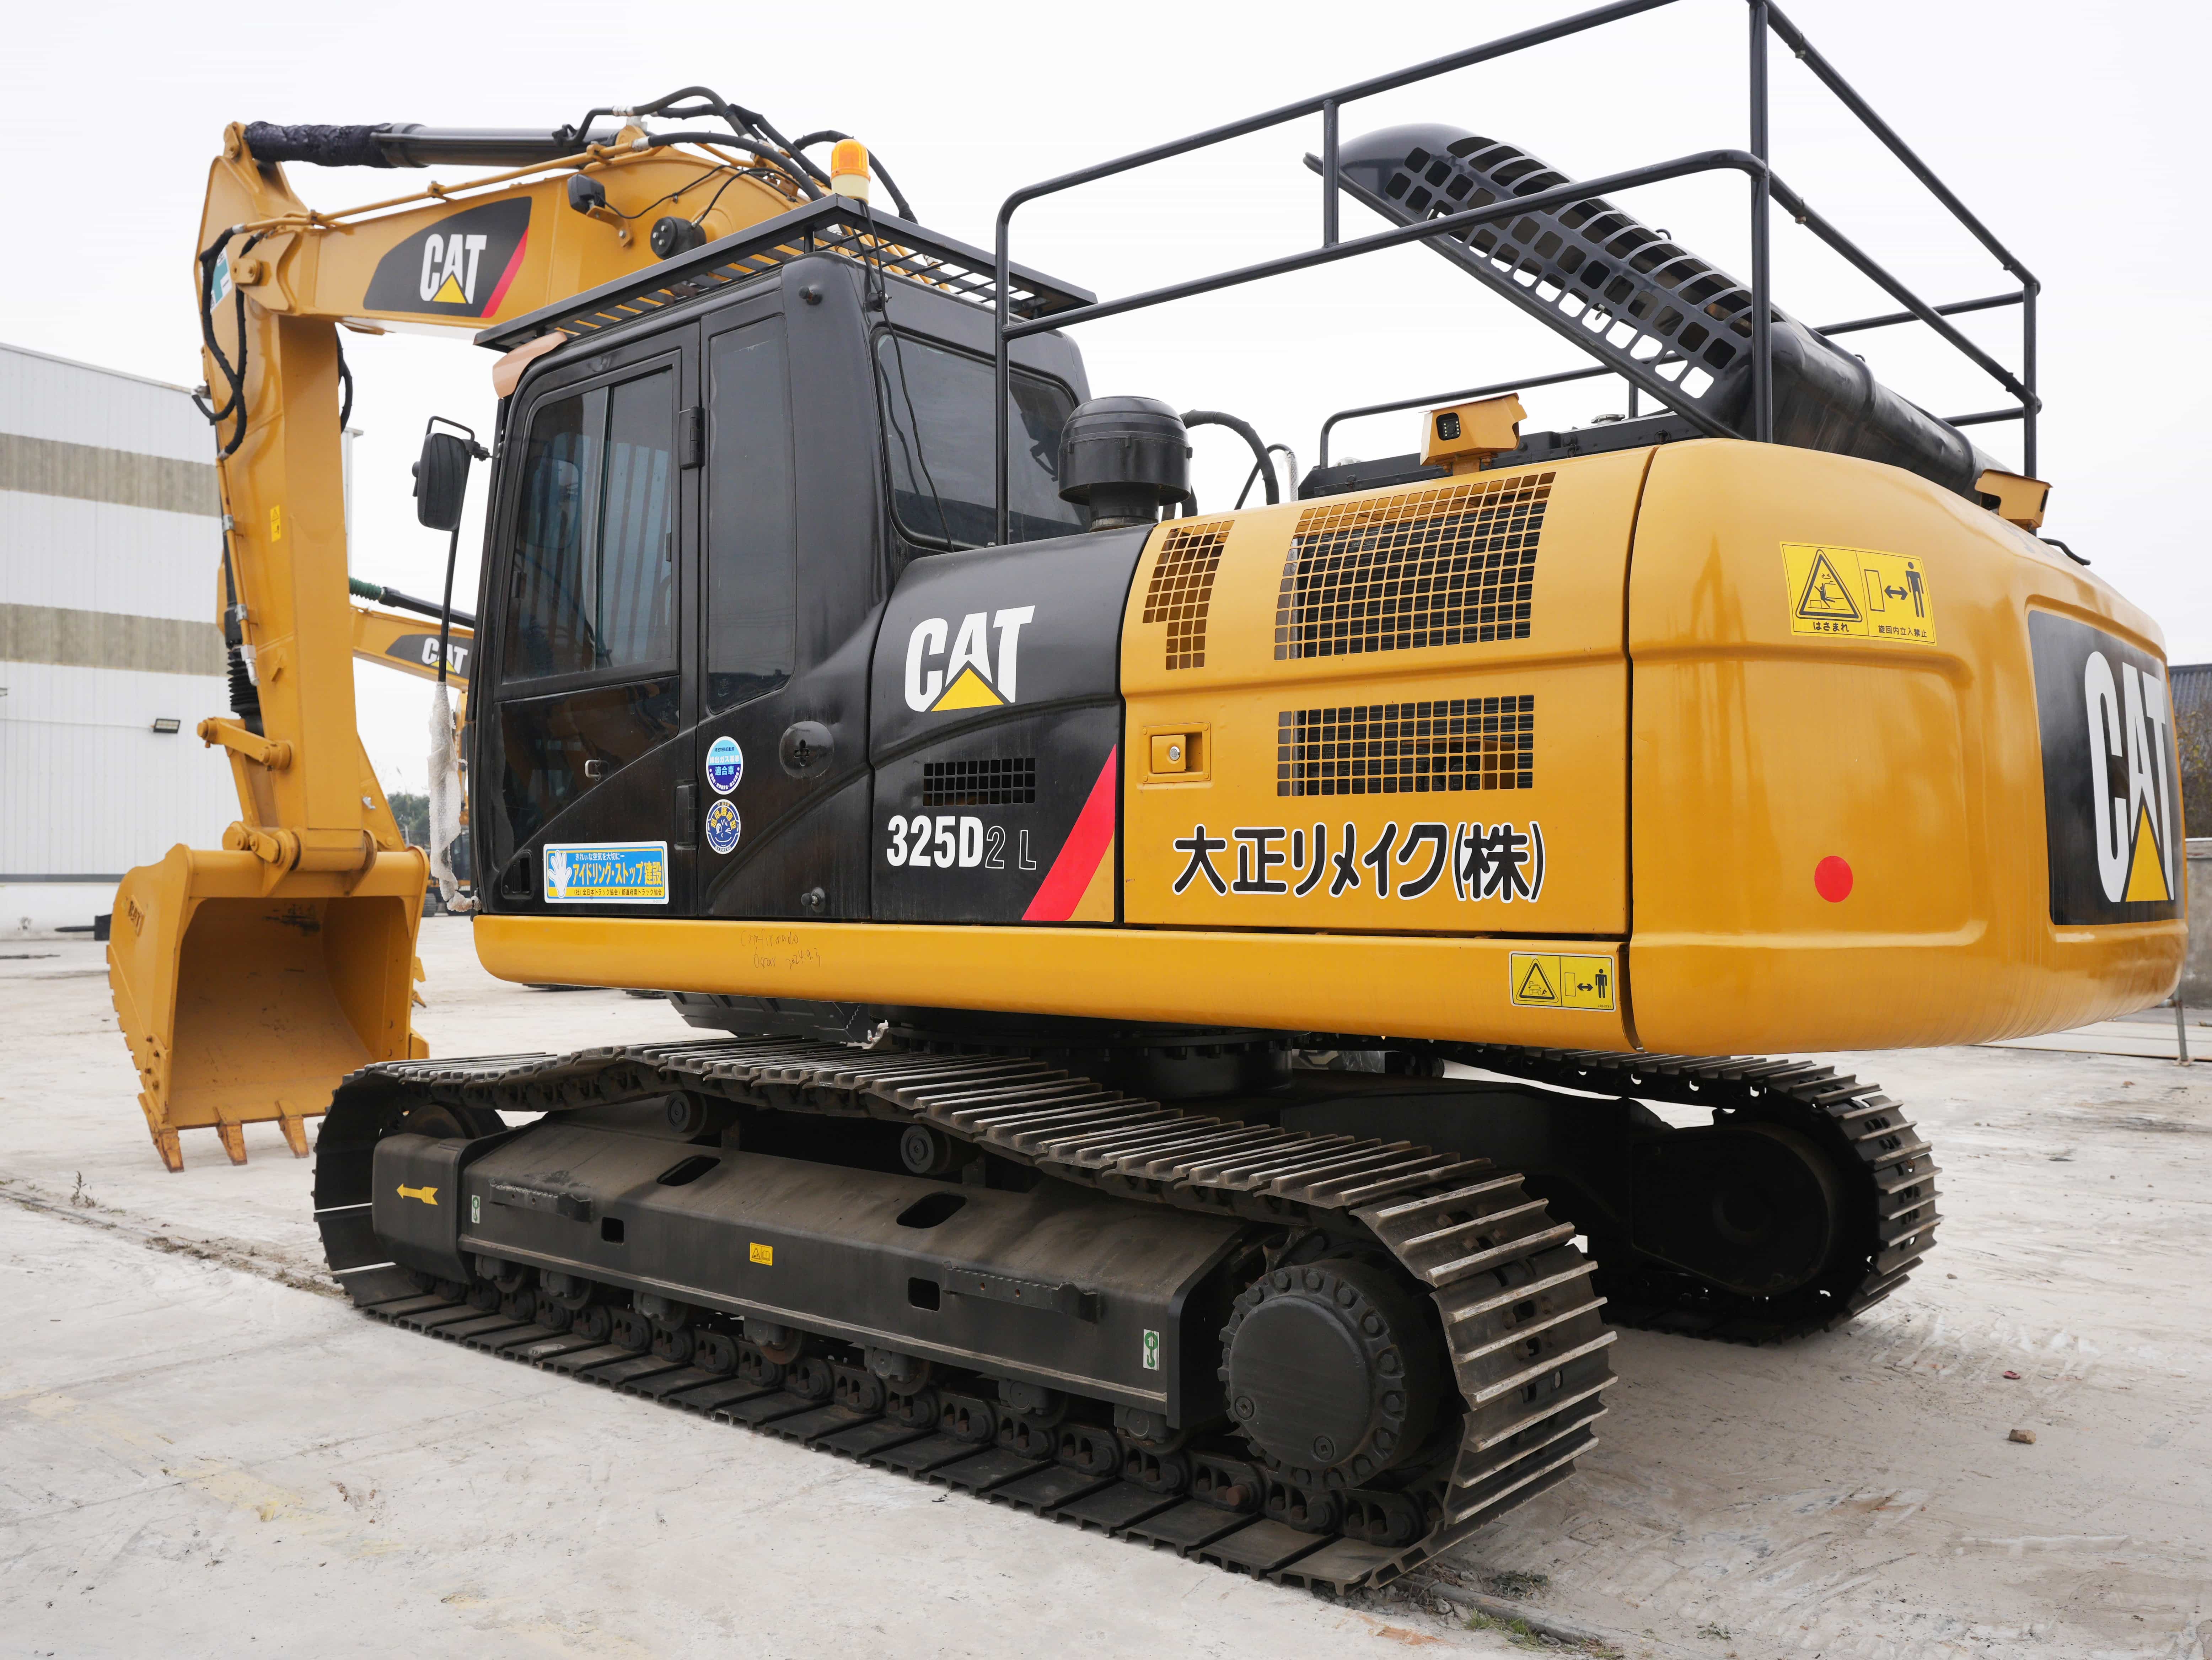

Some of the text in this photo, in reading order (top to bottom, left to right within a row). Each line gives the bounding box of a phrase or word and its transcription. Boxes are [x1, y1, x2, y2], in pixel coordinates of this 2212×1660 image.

[420, 233, 487, 304] CAT
[1813, 621, 1849, 632] はさまれ
[1878, 625, 1927, 638] 旋回内立入禁止
[905, 605, 1035, 712] CAT
[715, 765, 734, 775] 適合車
[2084, 651, 2175, 903] CAT
[1019, 830, 1037, 870] L
